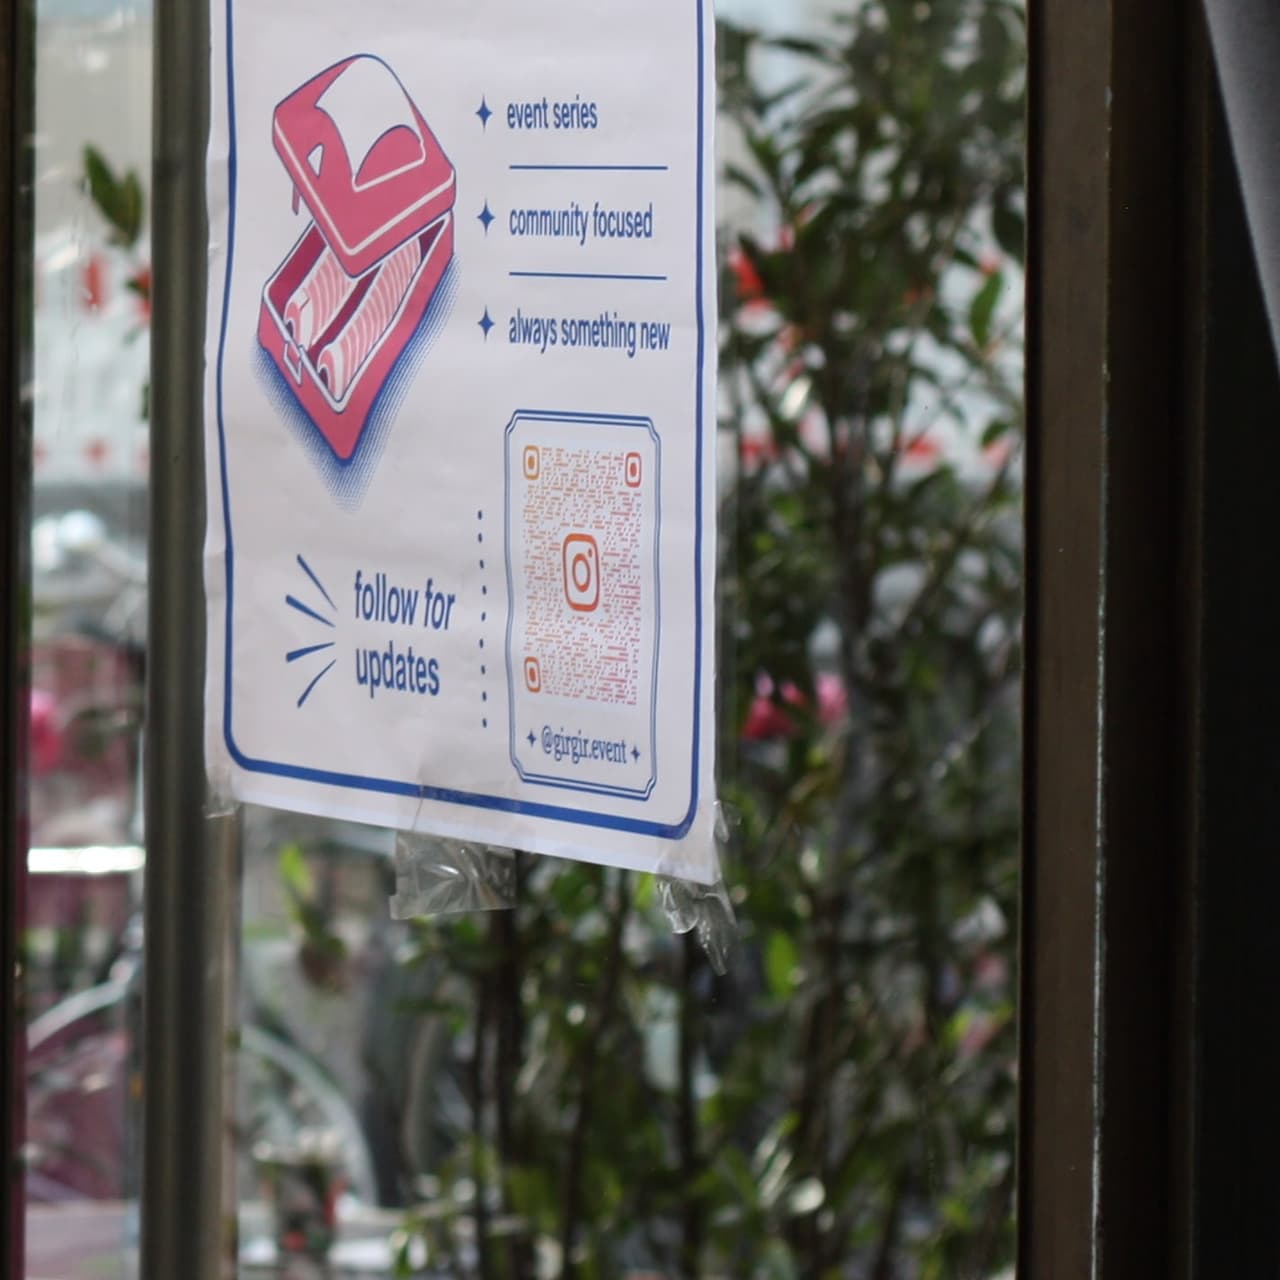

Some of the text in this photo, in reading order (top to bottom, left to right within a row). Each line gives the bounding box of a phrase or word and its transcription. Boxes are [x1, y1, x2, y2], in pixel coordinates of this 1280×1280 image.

[506, 94, 598, 129] event series
[508, 201, 653, 246] community focused
[508, 307, 671, 358] always something new
[354, 570, 456, 630] follow for
[355, 641, 440, 699] updates
[541, 724, 628, 764] @girgir.event
